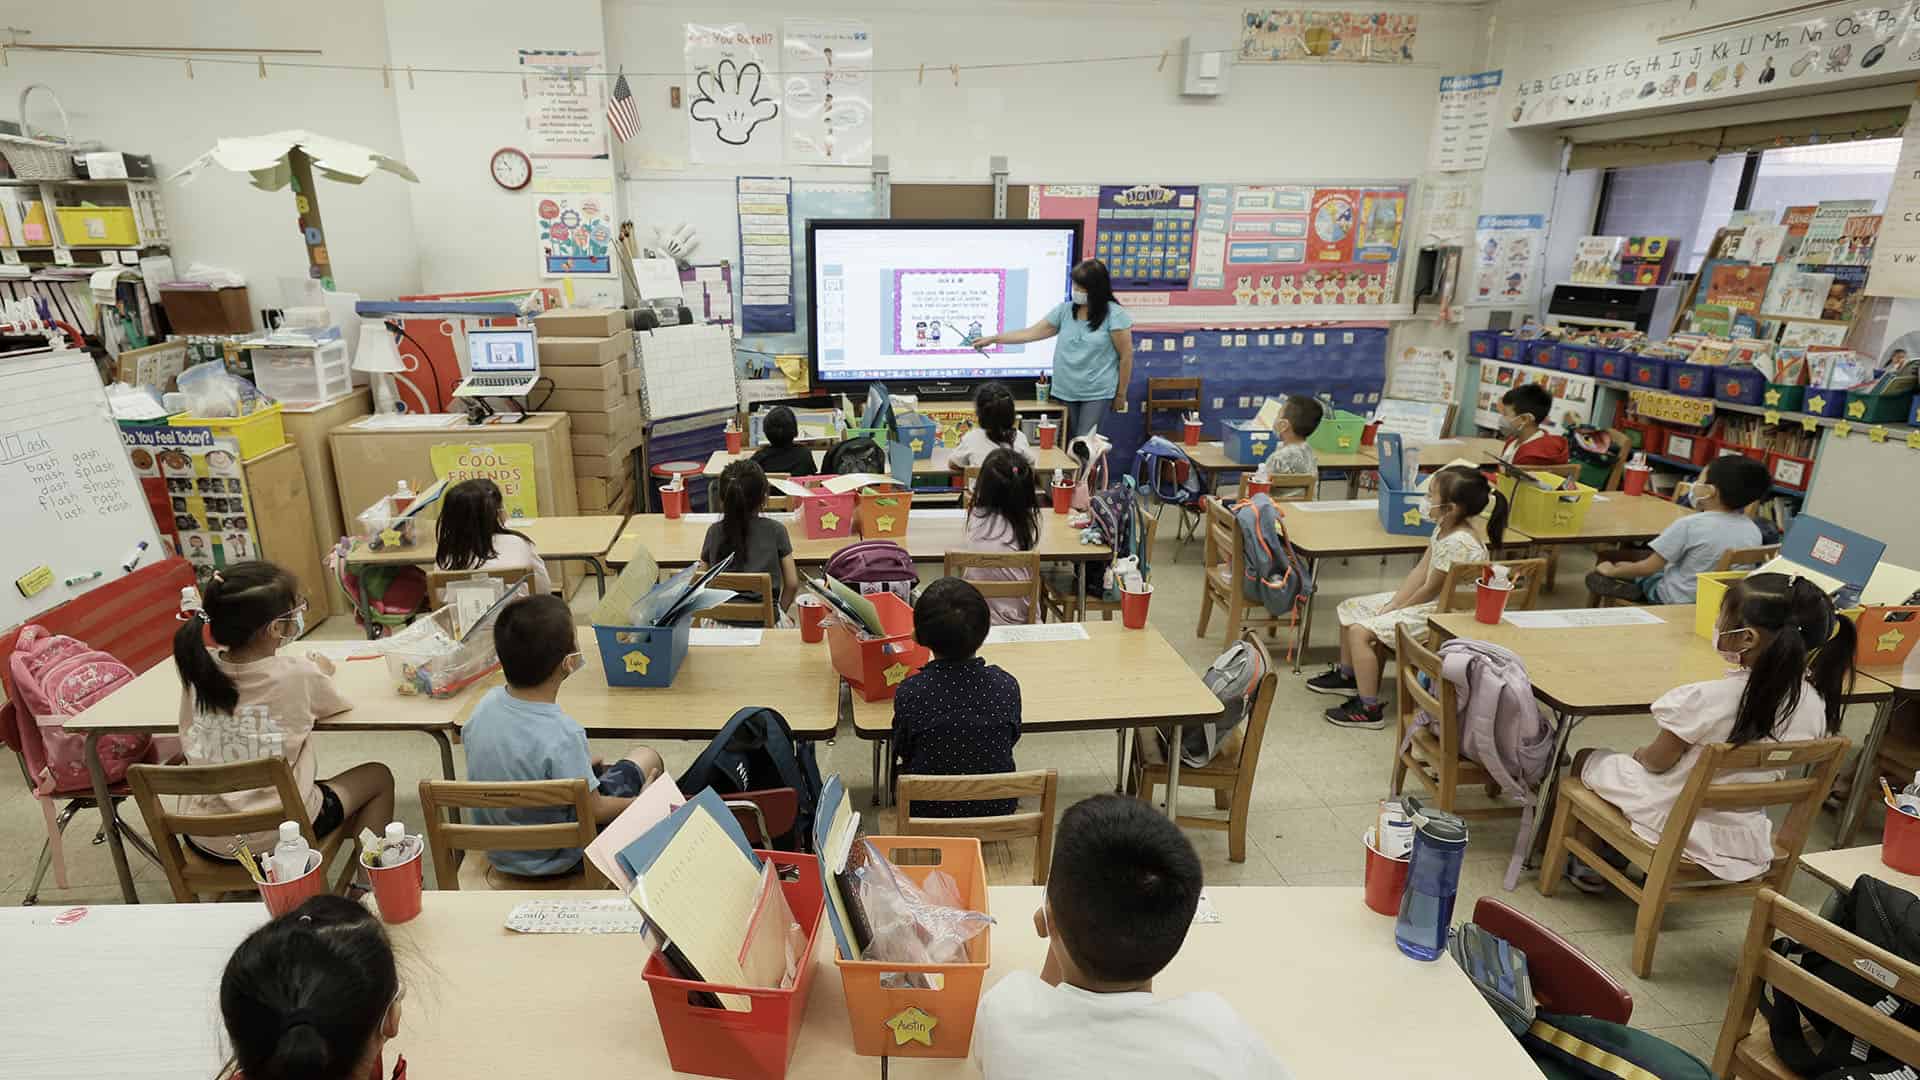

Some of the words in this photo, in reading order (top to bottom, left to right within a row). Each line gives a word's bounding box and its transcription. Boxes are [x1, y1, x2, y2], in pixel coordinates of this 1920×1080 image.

[1762, 31, 1790, 51] Mm
[1801, 25, 1823, 43] Nn
[1835, 17, 1861, 37] Oo
[136, 431, 154, 446] You
[155, 431, 175, 445] Feel
[457, 455, 510, 468] COOL
[447, 467, 522, 482] FRIENDS
[897, 1020, 925, 1032] Austin
